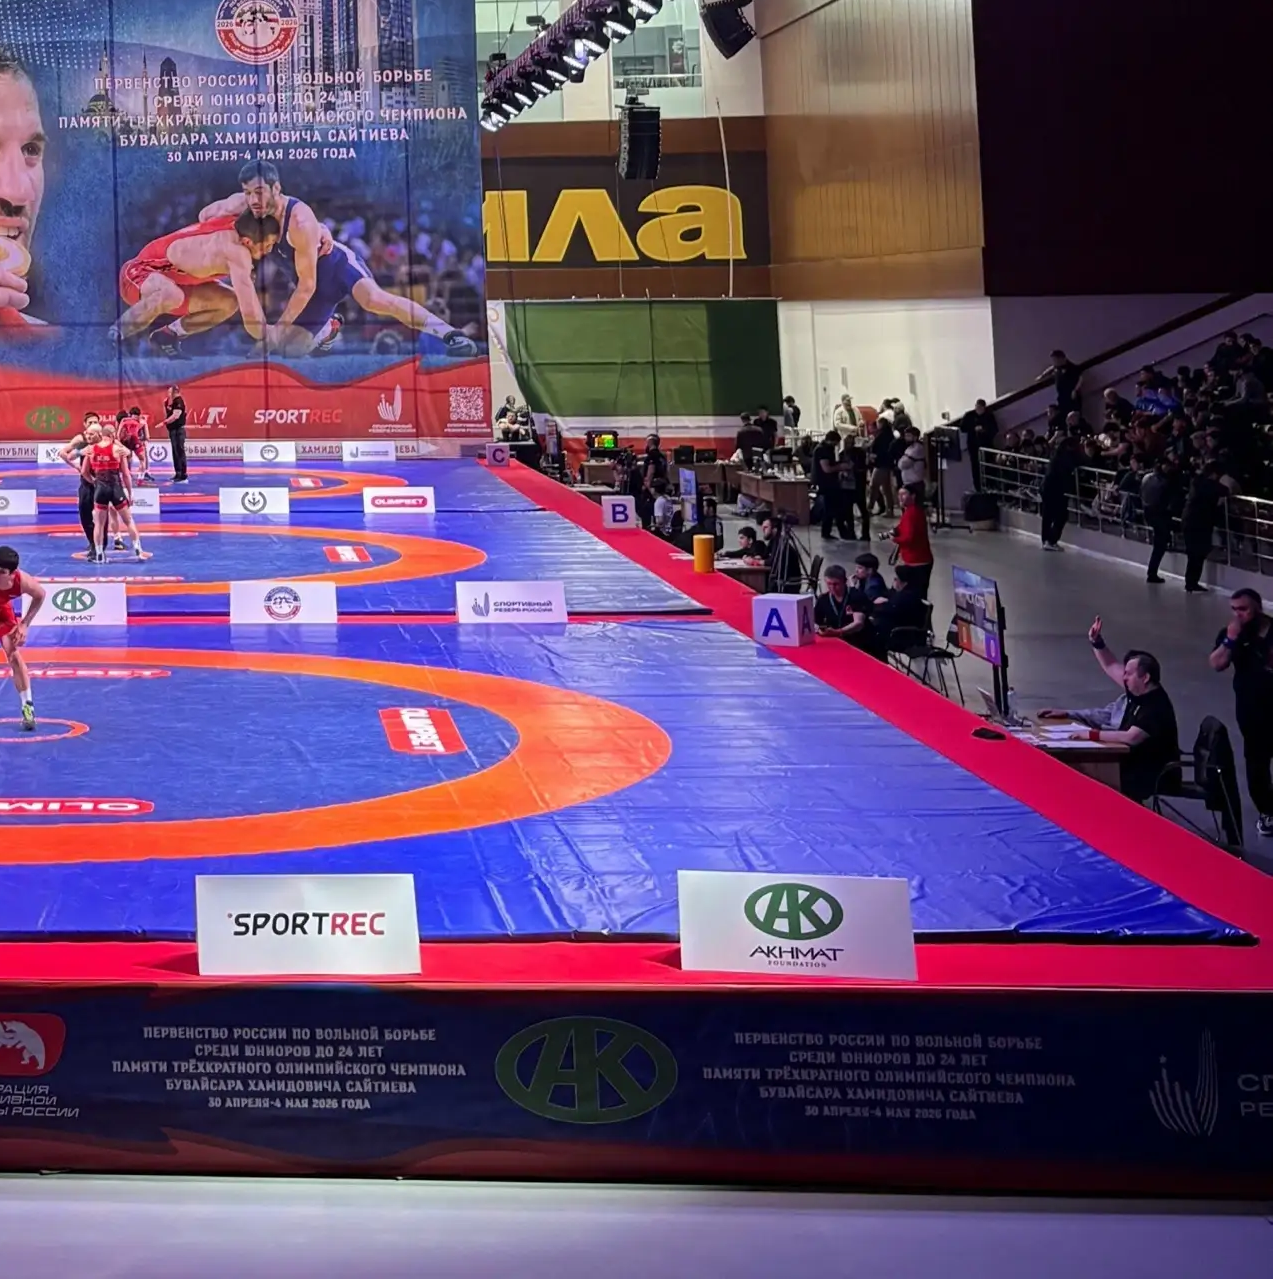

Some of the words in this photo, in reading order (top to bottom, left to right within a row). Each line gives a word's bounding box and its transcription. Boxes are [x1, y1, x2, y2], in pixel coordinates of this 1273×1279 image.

[95, 76, 191, 90] ПЕРВЕНСТВО
[198, 74, 259, 88] РОССИИ
[266, 73, 286, 85] ПО
[293, 69, 365, 84] ВОЛЬНОЙ
[373, 69, 433, 83] БОРЬБЕ
[153, 94, 203, 109] СРЕДИ
[211, 93, 285, 106] ЮНИОРОВ
[293, 92, 314, 105] ДО
[319, 91, 337, 103] 24
[343, 90, 371, 102] ЛЕТ
[59, 116, 121, 128] ПАМЯТИ
[247, 108, 375, 124] ОЛИМПИЙСКОГО
[380, 106, 467, 120] ЧЕМПИОНА
[119, 132, 209, 146] БУВАЙСАРА
[215, 130, 322, 144] ХАМИДОВИЧА
[327, 127, 409, 142] САЙТИЕВА
[167, 152, 181, 162] 30
[187, 150, 252, 162] АПРЕЛЯ-4
[257, 149, 283, 160] МАЯ
[289, 148, 318, 160] 2026
[323, 147, 357, 159] ГОДА
[254, 408, 343, 424] SPORTREC
[301, 444, 341, 454] ХАМИДО
[493, 448, 505, 464] C
[611, 504, 629, 523] B
[493, 600, 552, 608] СПОРТИВНЫЙ
[51, 614, 96, 622] AKHMAT
[762, 608, 789, 638] A
[801, 605, 812, 636] A
[233, 912, 386, 936] SPORTREC
[749, 945, 845, 962] AKHMAT
[767, 960, 827, 968] FOUNDATION
[143, 1026, 228, 1039] ПЕРВЕНСТВО
[232, 1027, 287, 1039] РОССИИ
[291, 1027, 311, 1040] ПО
[314, 1027, 379, 1040] ВОЛЬНОЙ
[383, 1028, 437, 1040] БОРЬБЕ
[193, 1043, 239, 1057] СРЕДИ
[244, 1044, 311, 1057] ЮНИОРОВ
[314, 1045, 334, 1058] ДО
[337, 1045, 353, 1057] 24
[357, 1045, 385, 1057] ЛЕТ
[111, 1060, 167, 1072] ПАМЯТИ
[171, 1061, 271, 1073] ТРЁХКРАТНОГО
[274, 1062, 386, 1074] ОЛИМПИЙСКОГО
[389, 1063, 467, 1075] ЧЕМПИОНА
[164, 1078, 244, 1091] БУВАЙСАРА
[247, 1079, 341, 1092] ХАМИДОВИЧА
[345, 1080, 416, 1093] САЙТИЕВА
[207, 1096, 222, 1107] 30
[224, 1097, 281, 1108] АПРЕЛЯ-4
[284, 1097, 309, 1108] МАЯ
[311, 1097, 339, 1108] 2026
[340, 1098, 371, 1109] ГОДА
[11, 1106, 80, 1118] РОССИИ
